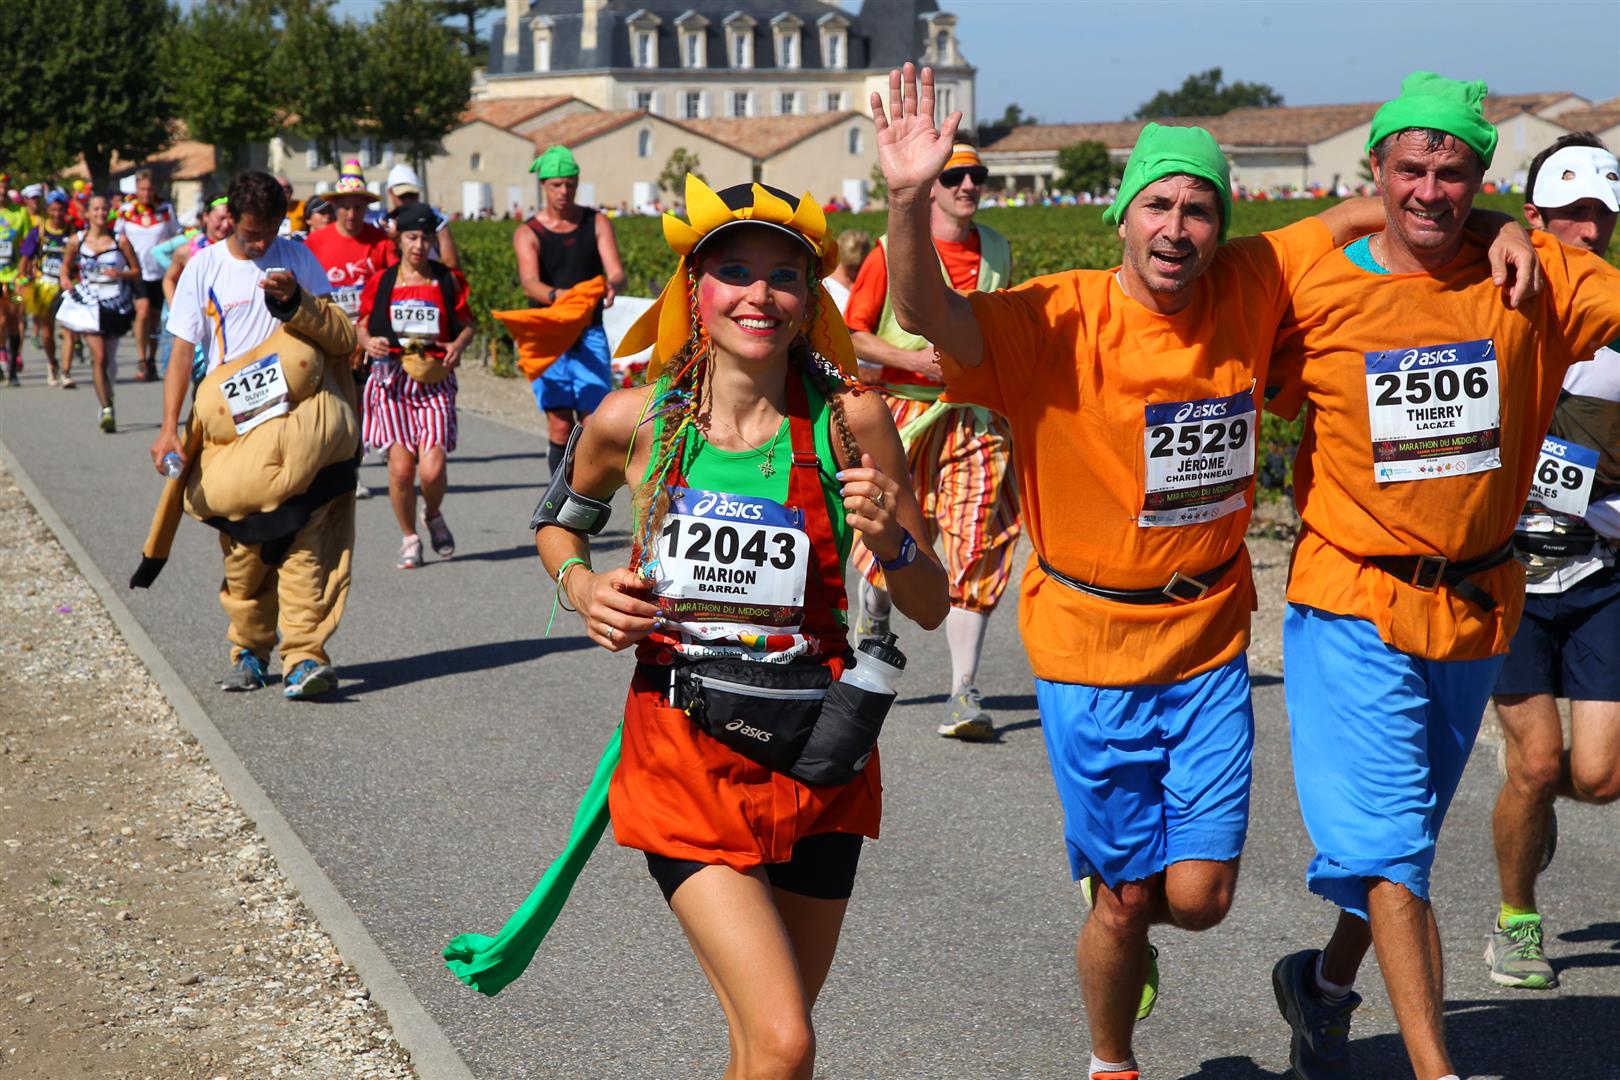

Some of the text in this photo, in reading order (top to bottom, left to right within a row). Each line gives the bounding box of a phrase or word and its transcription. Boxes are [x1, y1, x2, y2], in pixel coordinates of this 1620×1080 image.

[394, 309, 436, 321] 8765
[224, 367, 279, 399] 2122
[1375, 367, 1489, 406] 2506
[1406, 405, 1464, 422] THIERRY
[1416, 420, 1456, 431] LACAZE
[1150, 418, 1248, 458] 2529
[1400, 440, 1439, 452] MARATHON
[1440, 439, 1450, 448] DU
[1177, 456, 1225, 473] JÉRÔME
[1166, 469, 1233, 483] CHARBONNEAU
[1538, 459, 1583, 490] 69
[1167, 489, 1200, 501] MARATHON
[1201, 486, 1212, 496] DU
[662, 519, 796, 570] 12043
[693, 565, 757, 585] MARION
[698, 583, 748, 595] BARRAL
[674, 603, 721, 613] MARATHON
[722, 605, 736, 614] DU
[737, 607, 770, 617] MEDOC
